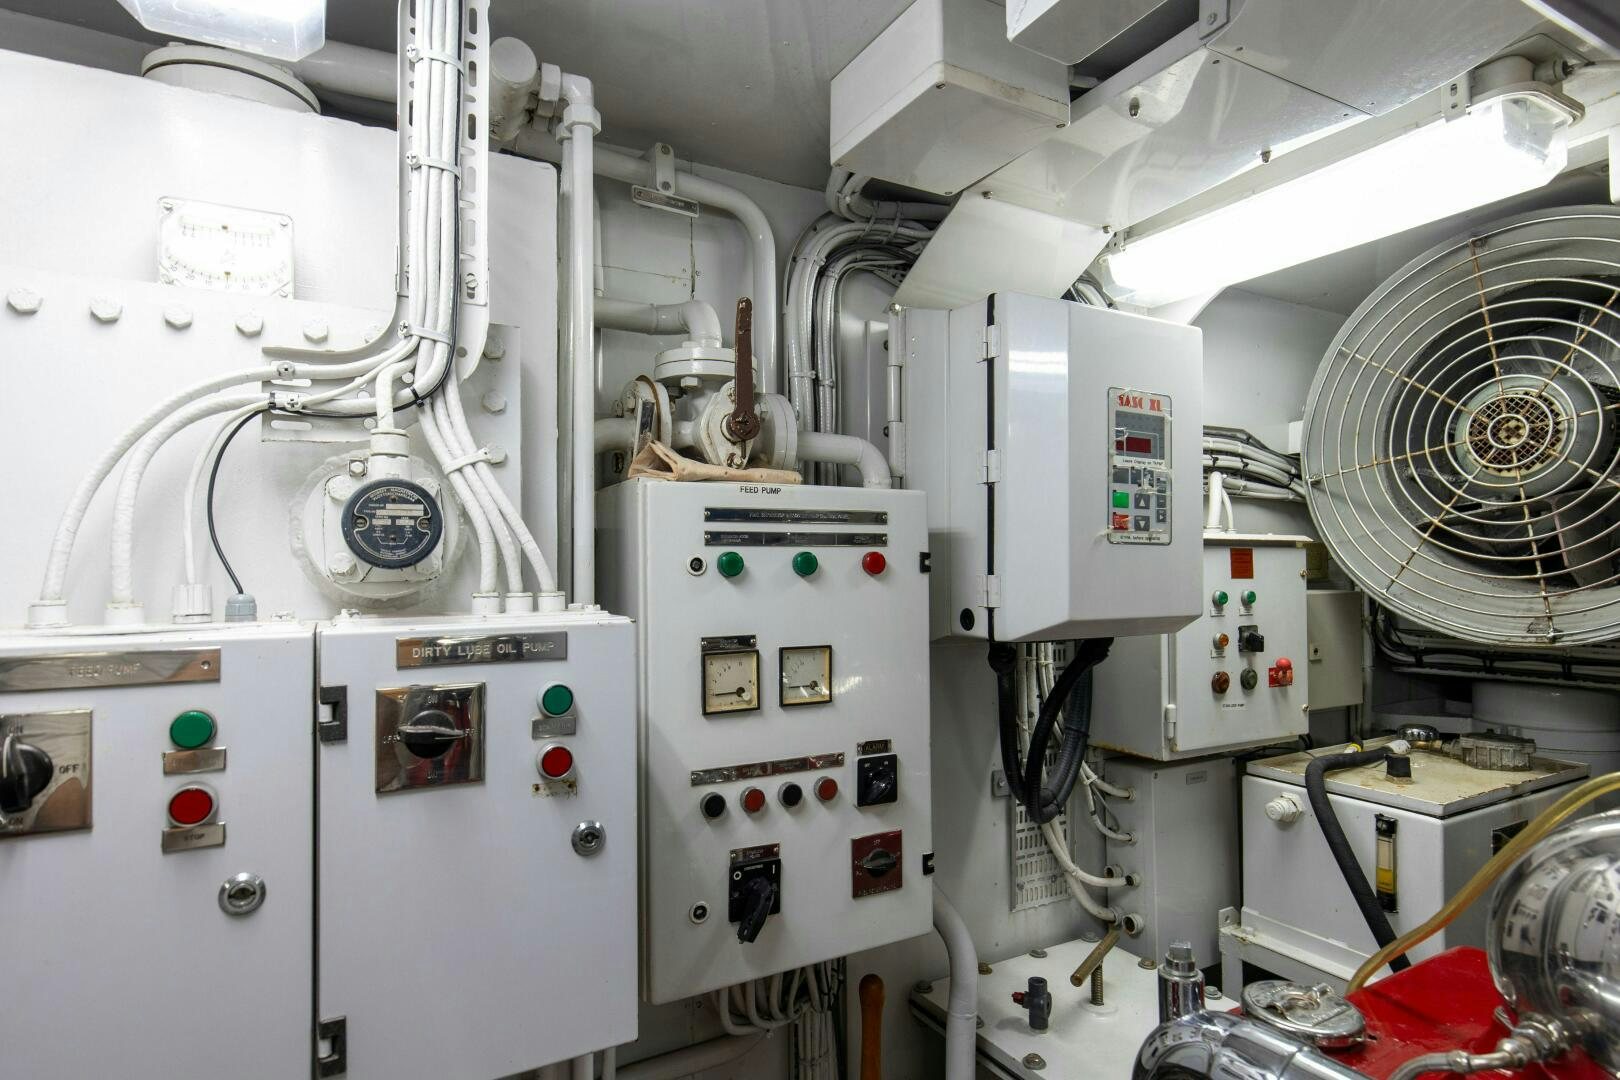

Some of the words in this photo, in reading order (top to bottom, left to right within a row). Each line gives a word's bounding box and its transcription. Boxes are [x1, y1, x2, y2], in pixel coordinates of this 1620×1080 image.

[740, 485, 759, 494] FEED
[761, 486, 782, 495] PUMP
[412, 646, 451, 658] DIRTY
[496, 642, 517, 654] OIL
[522, 641, 555, 653] PUMP
[107, 662, 142, 676] PUMP
[58, 763, 80, 774] OFF
